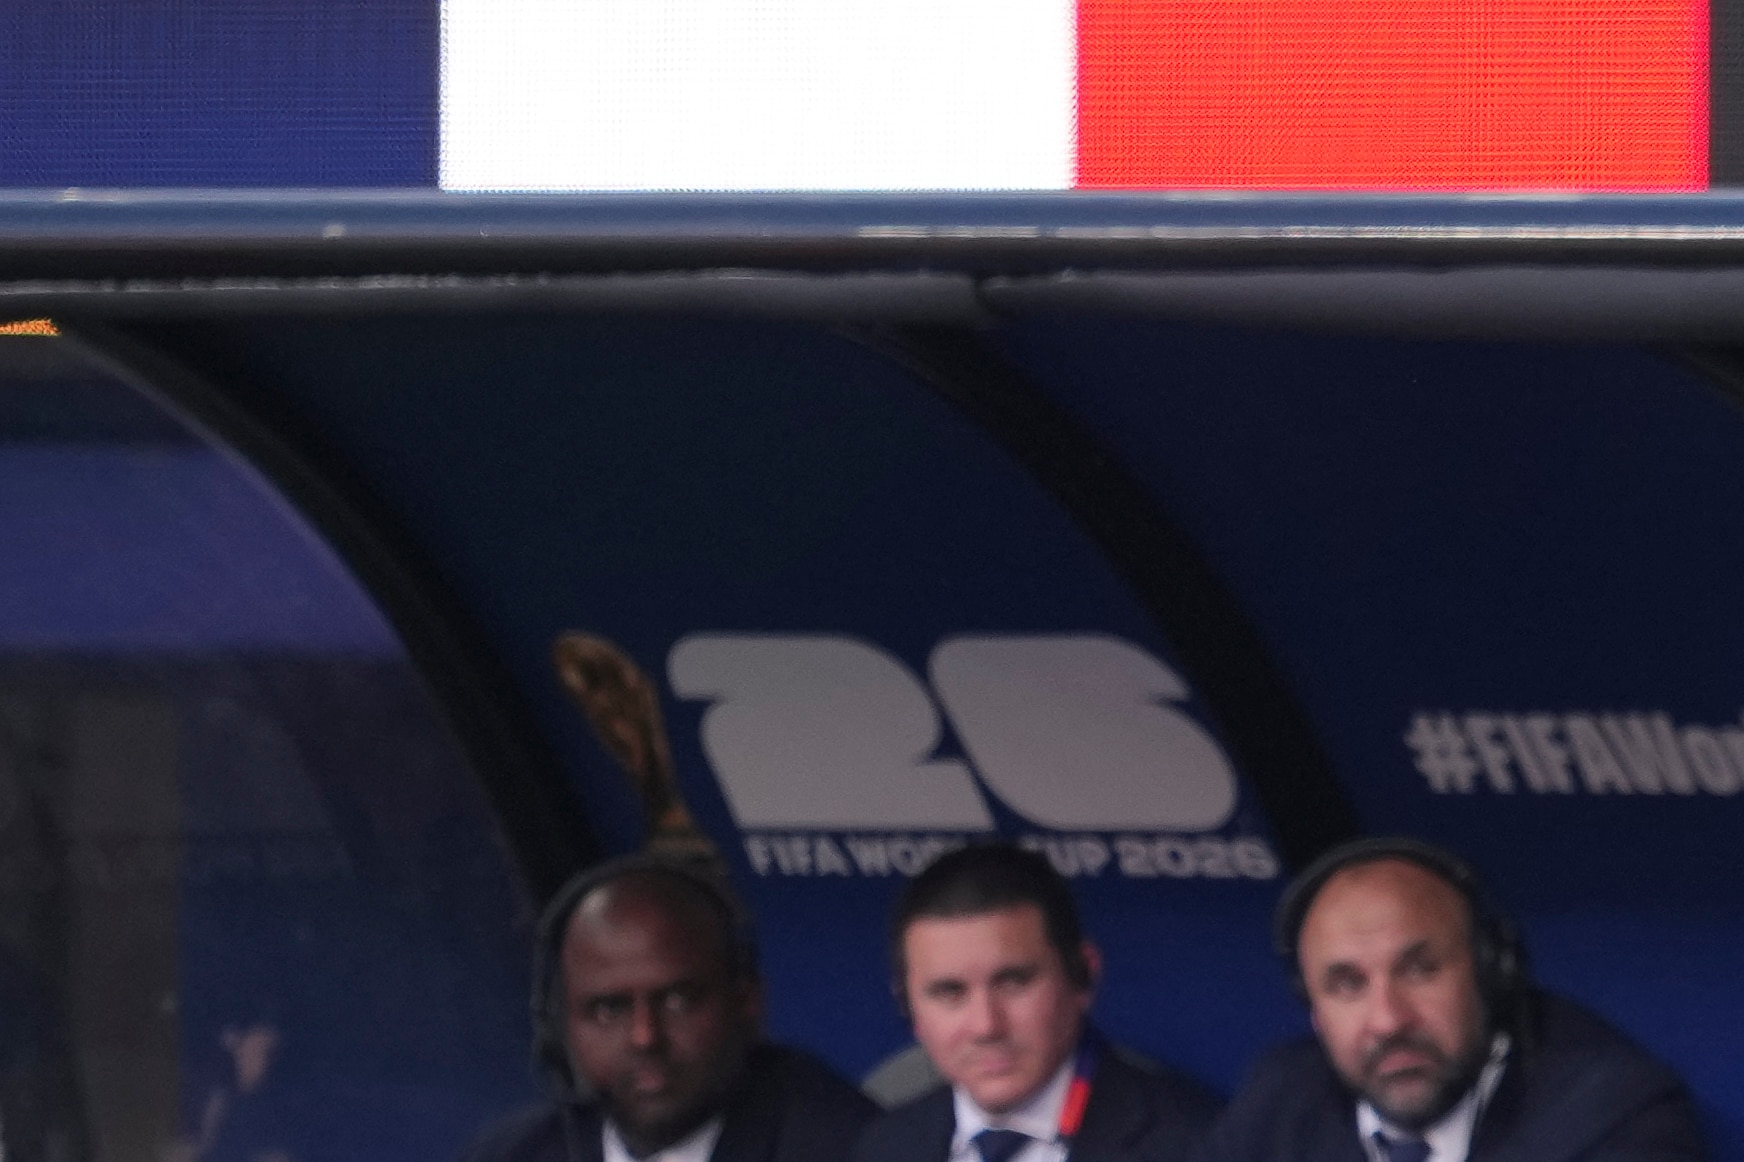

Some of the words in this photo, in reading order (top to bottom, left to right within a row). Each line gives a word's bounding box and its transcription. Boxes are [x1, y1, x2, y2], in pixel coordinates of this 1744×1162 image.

[742, 837, 850, 876] FIFA
[1018, 835, 1110, 878] UP
[1113, 837, 1278, 878] 2026
